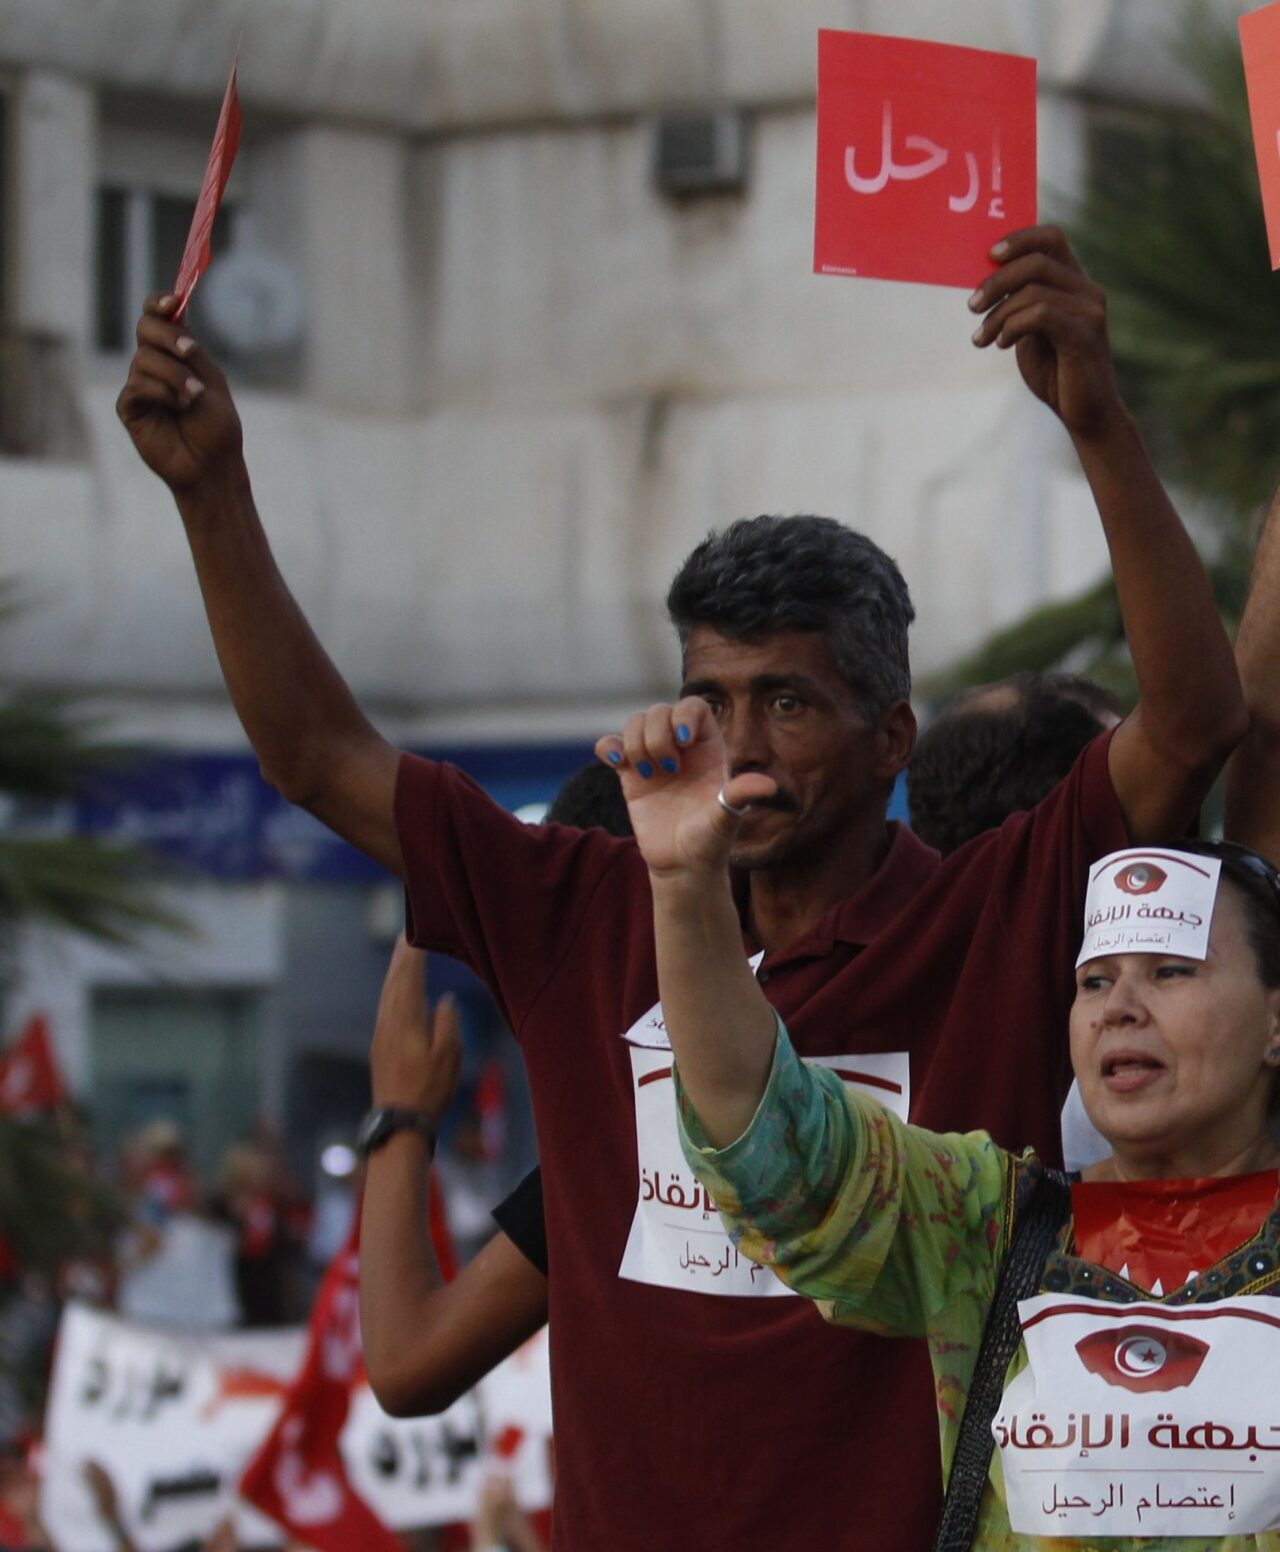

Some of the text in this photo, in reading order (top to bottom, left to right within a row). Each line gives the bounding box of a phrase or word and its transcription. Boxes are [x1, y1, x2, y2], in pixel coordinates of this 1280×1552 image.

[844, 100, 1005, 219] إرحل
[1137, 902, 1203, 930] جبهة
[679, 1242, 739, 1277] الرحيل
[1042, 1482, 1236, 1522] إعتصام الرحيل
